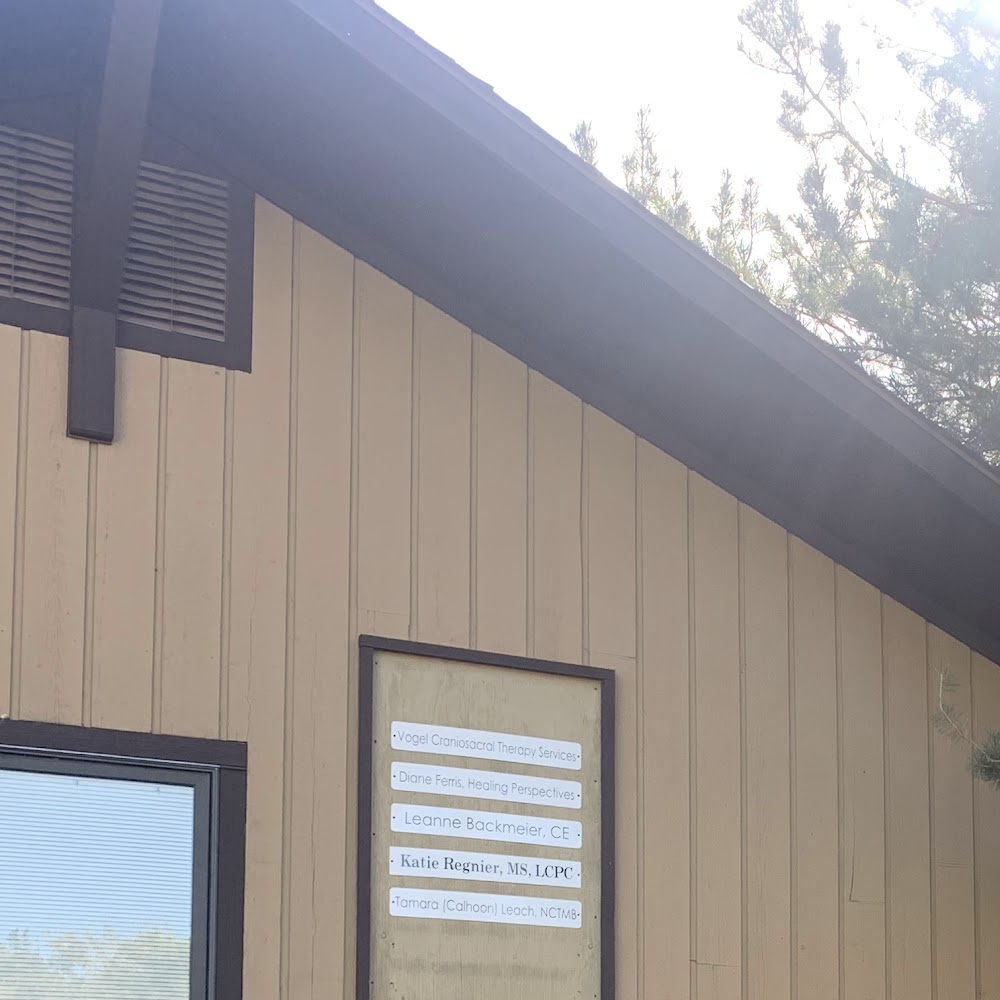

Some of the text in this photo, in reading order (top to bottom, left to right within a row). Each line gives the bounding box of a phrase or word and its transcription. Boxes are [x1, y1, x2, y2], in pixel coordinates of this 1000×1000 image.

[397, 730, 577, 762] Vogel Craniosacral Therapy Services
[399, 770, 432, 785] Diane
[468, 778, 509, 796] Healing
[511, 782, 575, 801] Perspectives
[405, 811, 570, 840] Leanne Backmeier, CE
[400, 854, 573, 880] Katie Regnier, MS, LCPC
[395, 895, 439, 910] Tamara
[442, 899, 498, 916] (Calhoon)
[540, 907, 577, 921] NCTMB
